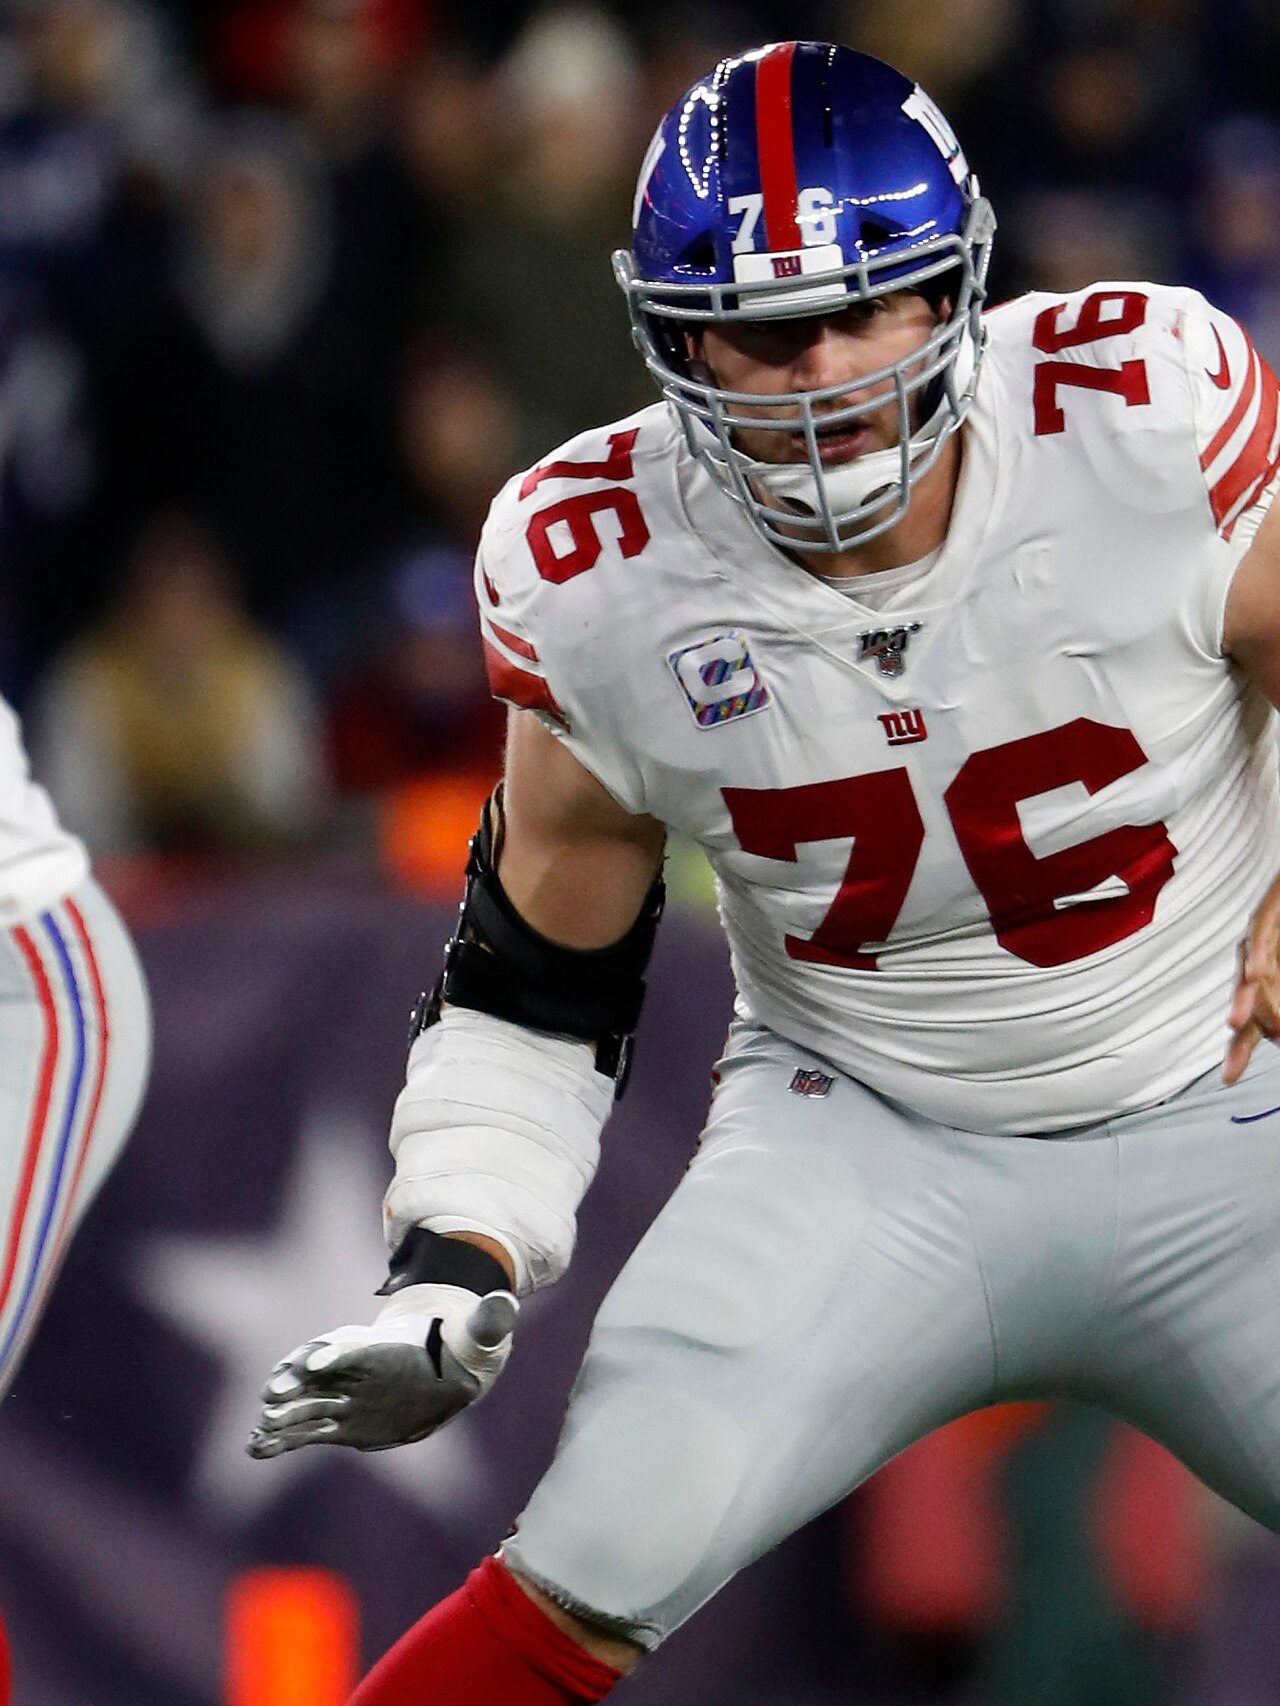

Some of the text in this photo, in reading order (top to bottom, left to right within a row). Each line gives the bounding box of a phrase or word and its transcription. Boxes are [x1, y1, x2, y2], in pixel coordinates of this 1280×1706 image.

[728, 187, 837, 253] 76
[1033, 291, 1151, 436] 76
[518, 427, 651, 585] 76
[720, 717, 1178, 970] 76
